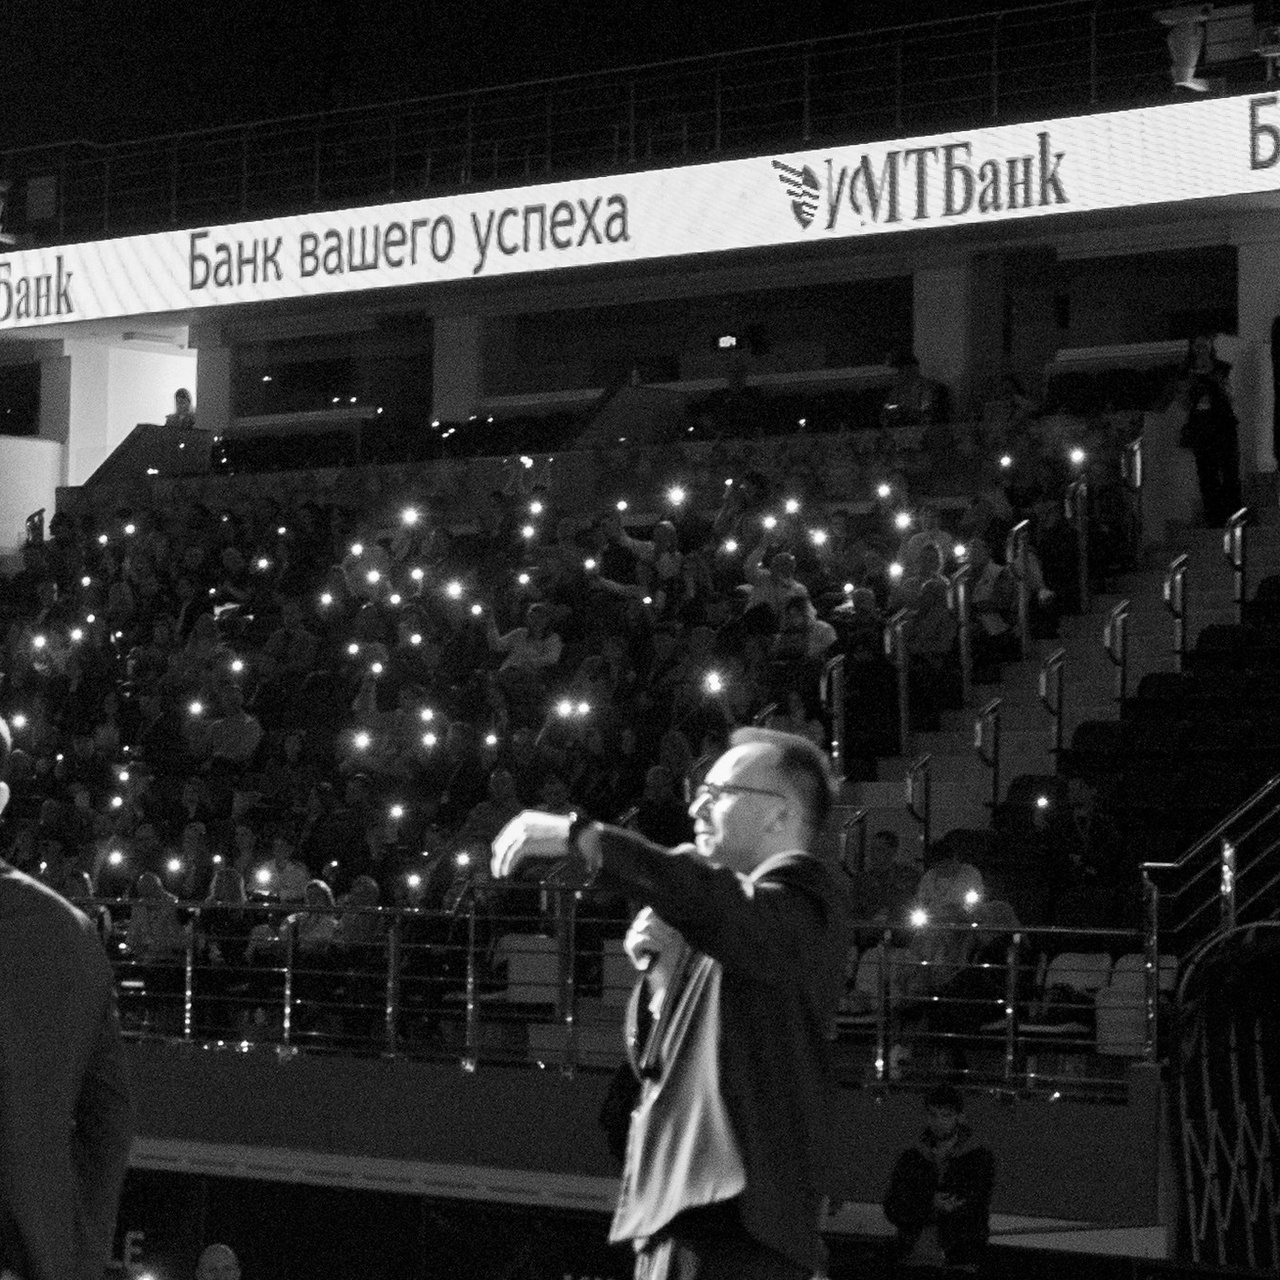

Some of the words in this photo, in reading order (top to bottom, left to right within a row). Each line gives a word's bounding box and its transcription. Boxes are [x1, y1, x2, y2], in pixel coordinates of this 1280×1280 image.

[188, 230, 284, 292] Банк
[298, 216, 456, 278] вашего
[470, 192, 631, 277] успеха
